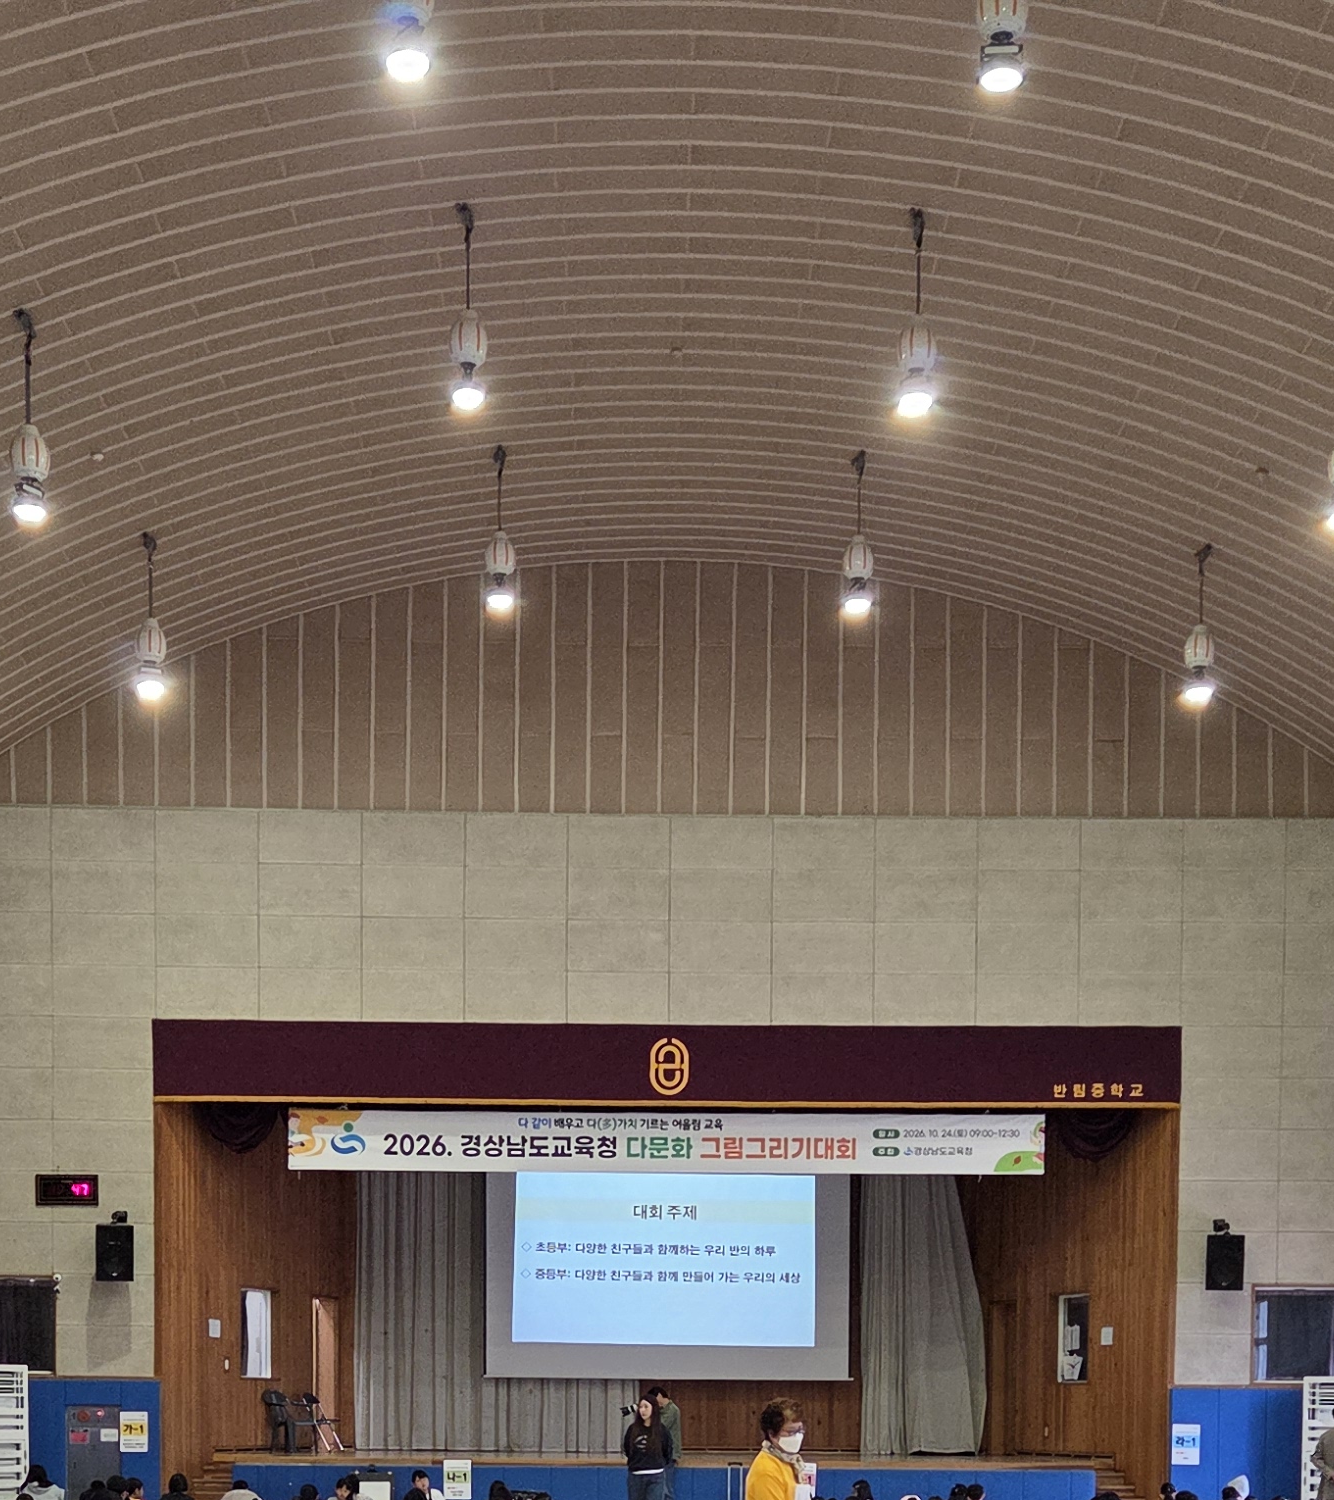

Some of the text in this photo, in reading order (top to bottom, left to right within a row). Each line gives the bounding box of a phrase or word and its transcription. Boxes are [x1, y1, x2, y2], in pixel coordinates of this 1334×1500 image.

[518, 1118, 529, 1129] 다
[531, 1118, 552, 1129] 같이
[554, 1118, 584, 1129] 배우고
[640, 1118, 669, 1130] 기르는
[672, 1118, 701, 1131] 어울림
[704, 1118, 724, 1131] 교육
[383, 1134, 857, 1160] 2026. 경상남도교육청 다문화 그림그리기대회
[633, 1204, 698, 1221] 대회 주제
[535, 1242, 776, 1257] 초등부: 다양한 친구들과 함께하는 우리 반의 하루
[535, 1268, 801, 1284] 중등부: 다양한 친구들과 함께 만들어 가는 우리의 세상
[123, 1424, 144, 1435] 가-1
[447, 1472, 467, 1482] 나-1
